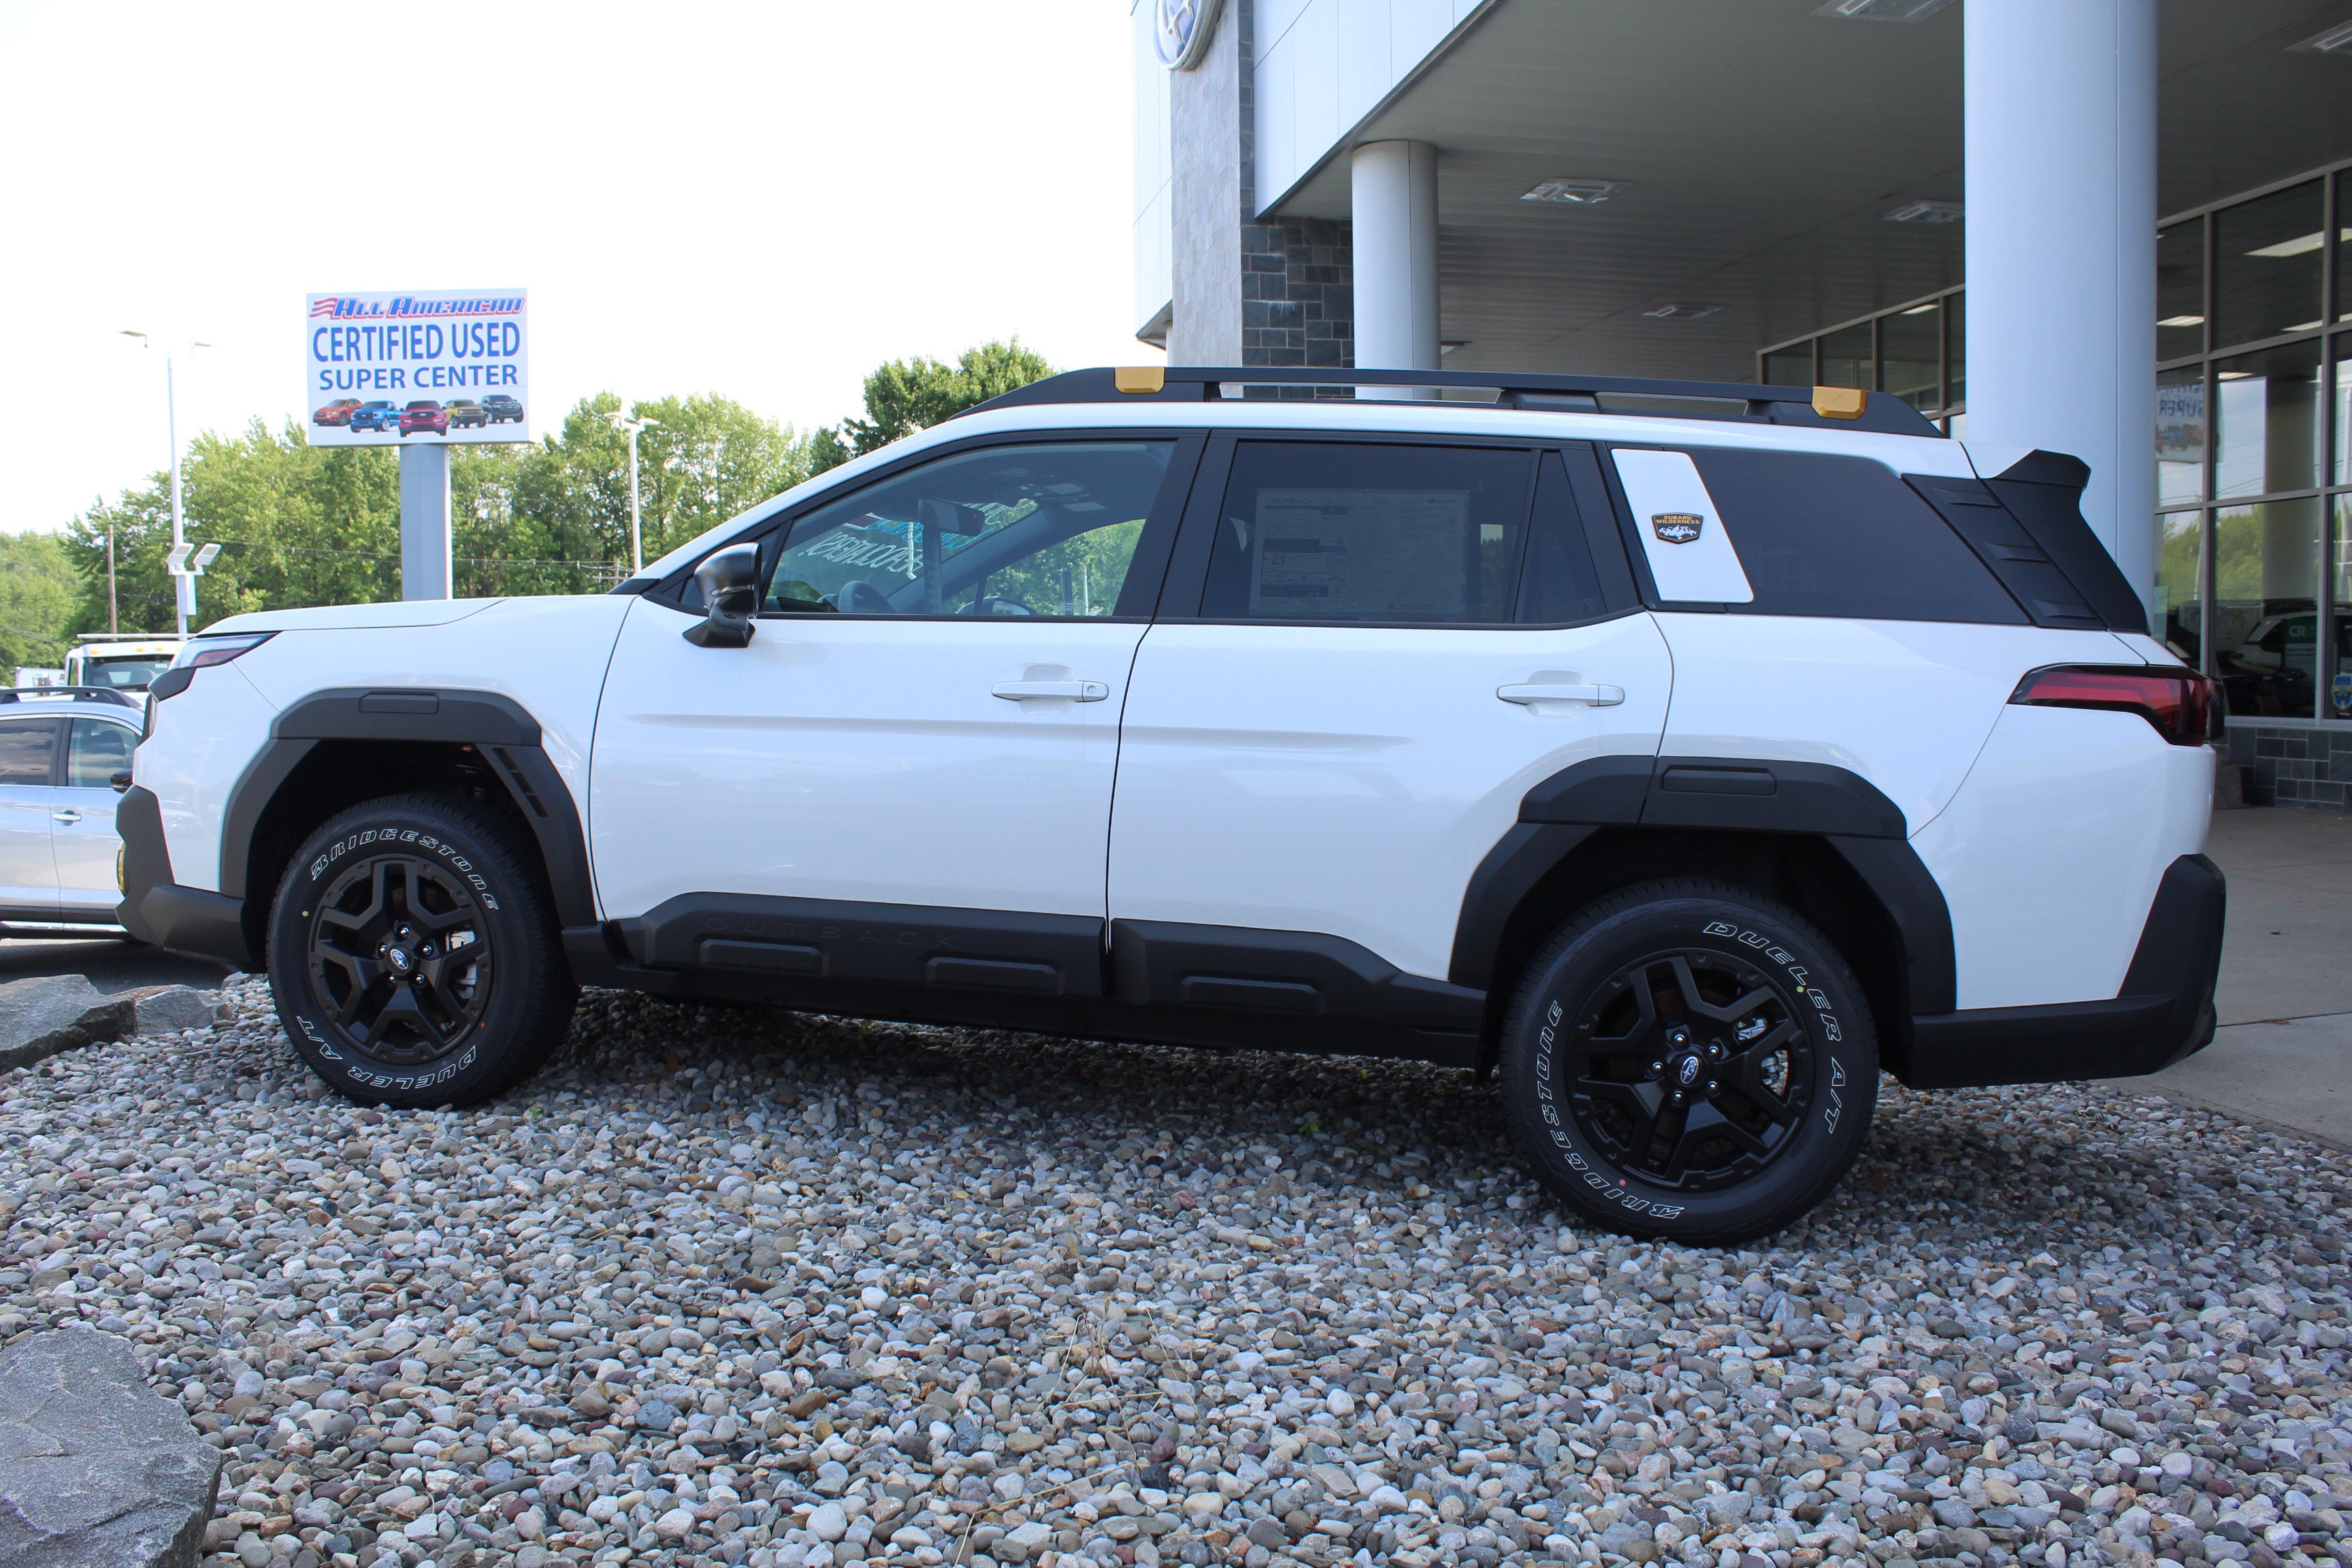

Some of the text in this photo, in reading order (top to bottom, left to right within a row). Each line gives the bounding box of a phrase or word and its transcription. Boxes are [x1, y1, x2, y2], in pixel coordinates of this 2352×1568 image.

[313, 322, 520, 362] CERTIFIED USED
[319, 364, 518, 391] SUPER CENTER
[1271, 555, 1285, 566] 23
[311, 829, 498, 910] BRIDGESTONE
[704, 915, 957, 949] OUTBACK
[297, 1016, 476, 1090] DUELER A/T
[1703, 921, 1846, 1134] DUELER A/T
[1537, 1000, 1685, 1220] BRIDGESTONE
